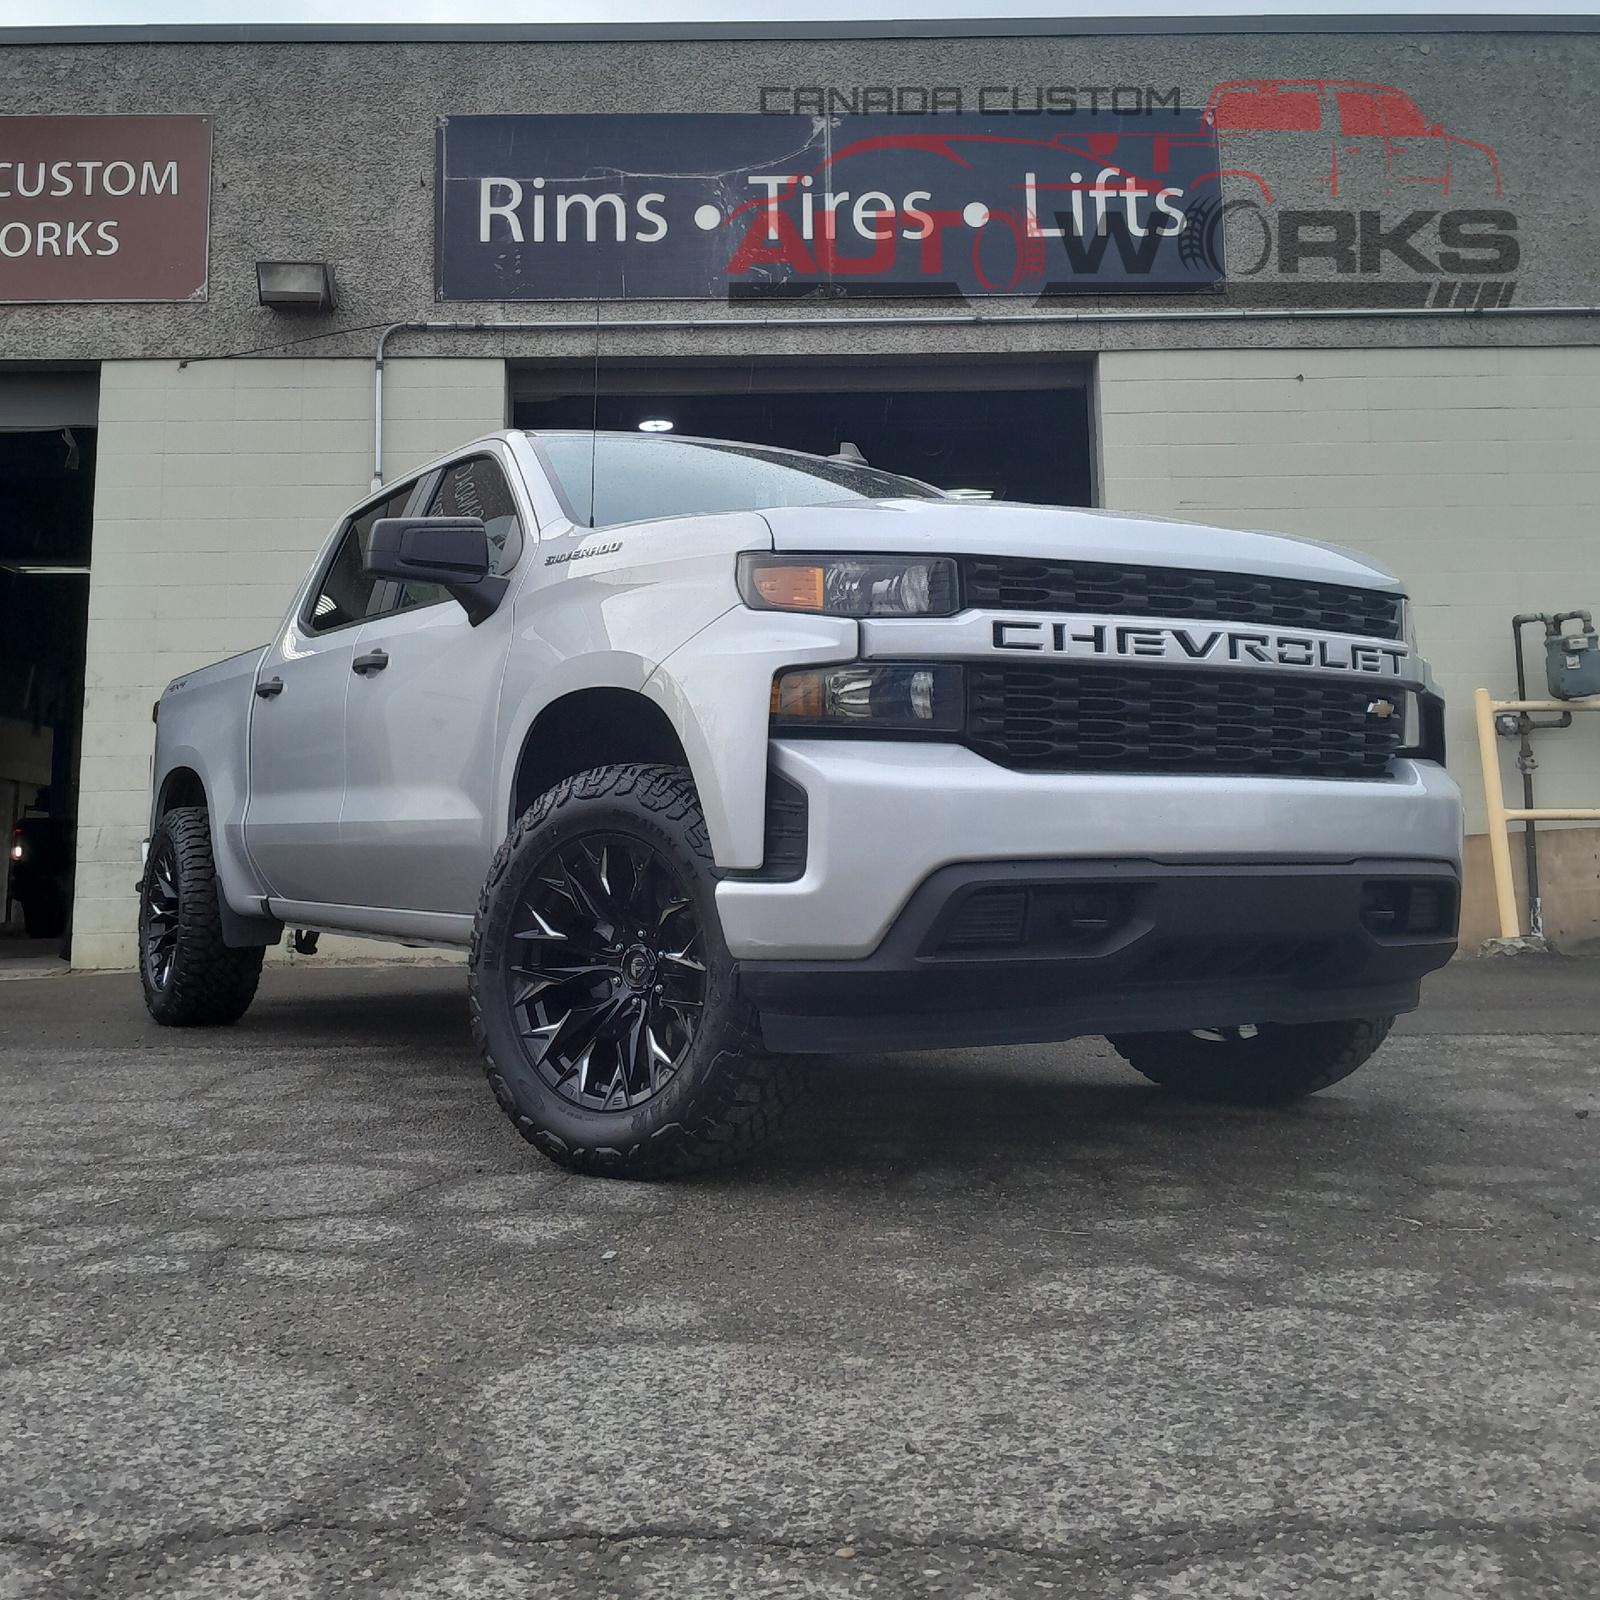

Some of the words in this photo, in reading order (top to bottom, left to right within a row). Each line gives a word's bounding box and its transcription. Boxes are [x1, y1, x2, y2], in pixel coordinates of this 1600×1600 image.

[479, 177, 668, 244] Rims
[748, 175, 934, 240] Tires
[1024, 167, 1187, 238] Lifts
[544, 541, 622, 566] SILVERADO
[993, 620, 1408, 675] CHEVROLET
